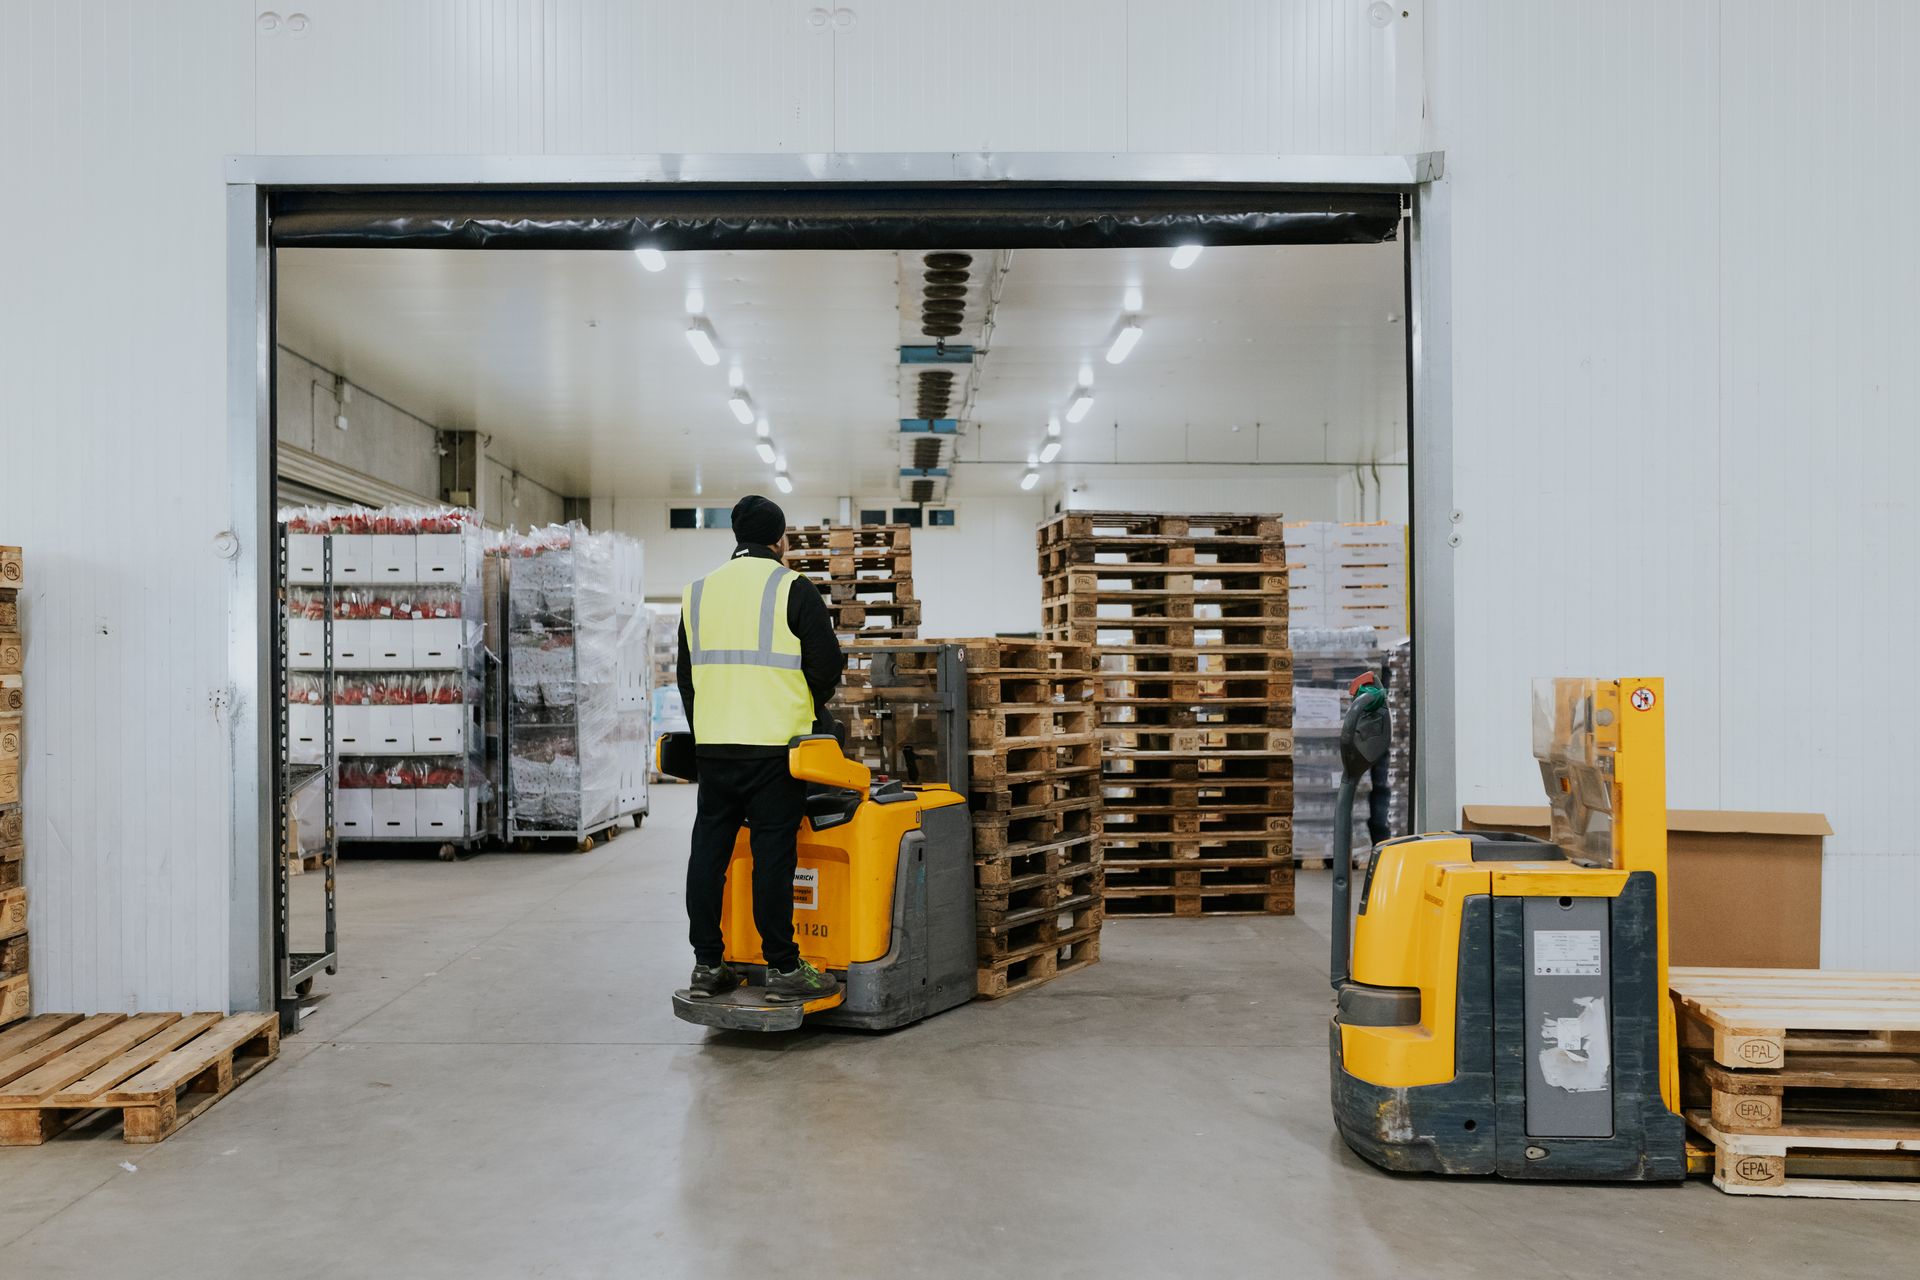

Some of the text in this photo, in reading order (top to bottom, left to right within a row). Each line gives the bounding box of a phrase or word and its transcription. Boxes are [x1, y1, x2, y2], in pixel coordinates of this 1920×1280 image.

[1744, 1044, 1774, 1059] EPAL
[1741, 1103, 1766, 1117] EPAL
[1742, 1161, 1773, 1176] EPAL
